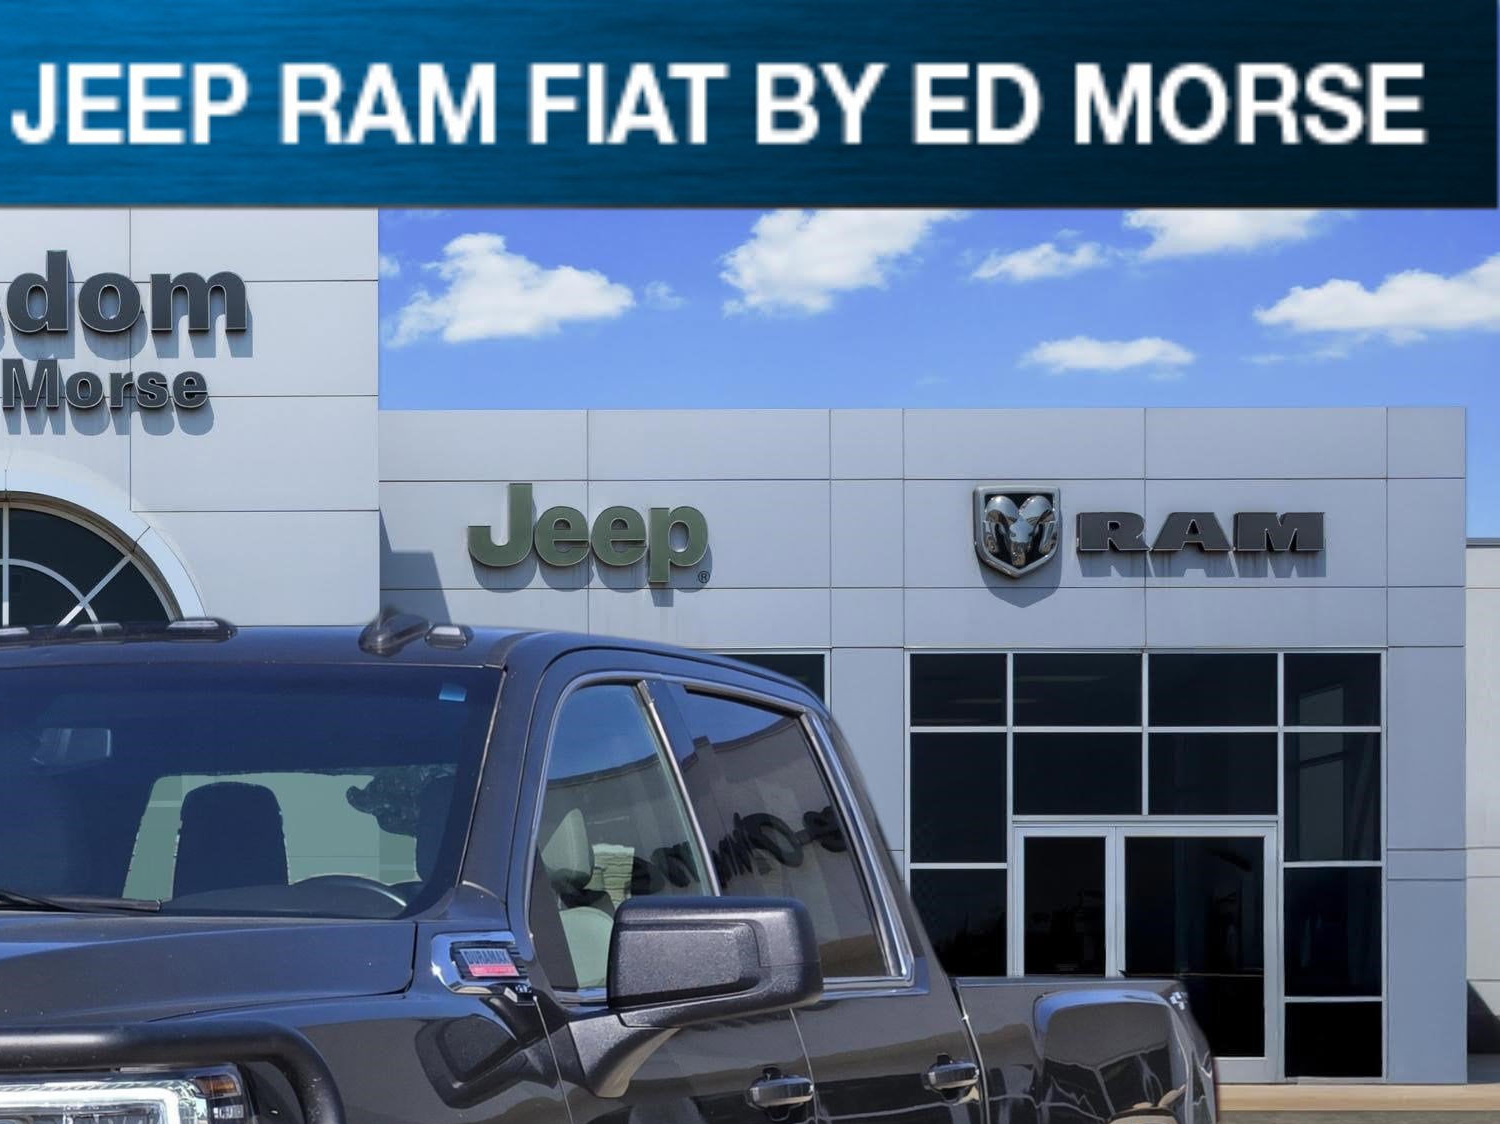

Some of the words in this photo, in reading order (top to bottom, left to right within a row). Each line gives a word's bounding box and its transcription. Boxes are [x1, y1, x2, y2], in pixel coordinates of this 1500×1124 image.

[2, 358, 209, 408] Morse
[467, 482, 709, 583] Jeep
[1076, 511, 1325, 552] RAM
